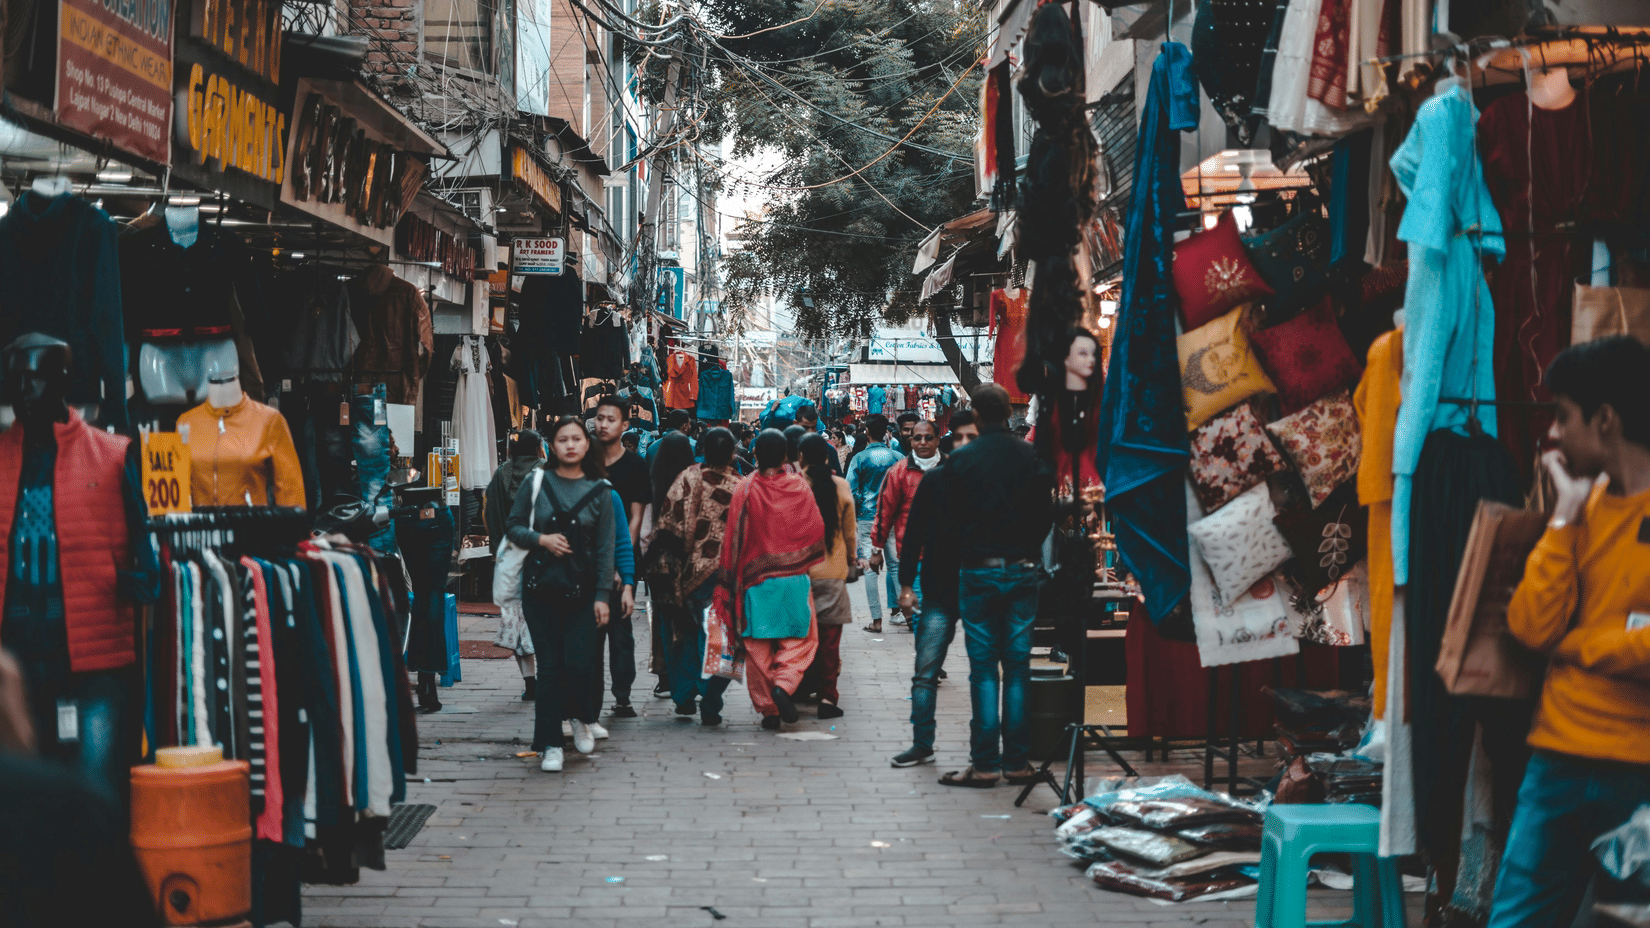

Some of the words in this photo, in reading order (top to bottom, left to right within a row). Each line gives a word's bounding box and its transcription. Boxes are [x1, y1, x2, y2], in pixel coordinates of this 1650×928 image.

[69, 14, 104, 50] INDIAN
[105, 33, 138, 69] ETHNIC
[141, 54, 168, 82] WEAR
[66, 59, 83, 86] Shop
[128, 89, 147, 113] Central
[147, 99, 165, 121] Market
[70, 86, 90, 112] Lajpat
[91, 96, 109, 121] Nagar
[115, 106, 127, 126] New
[128, 112, 142, 133] Delhi
[187, 63, 285, 185] GARMENTS
[516, 240, 522, 249] R
[525, 240, 531, 249] K
[534, 240, 558, 249] SOOD
[148, 451, 174, 472] SALE
[148, 478, 180, 508] 200
